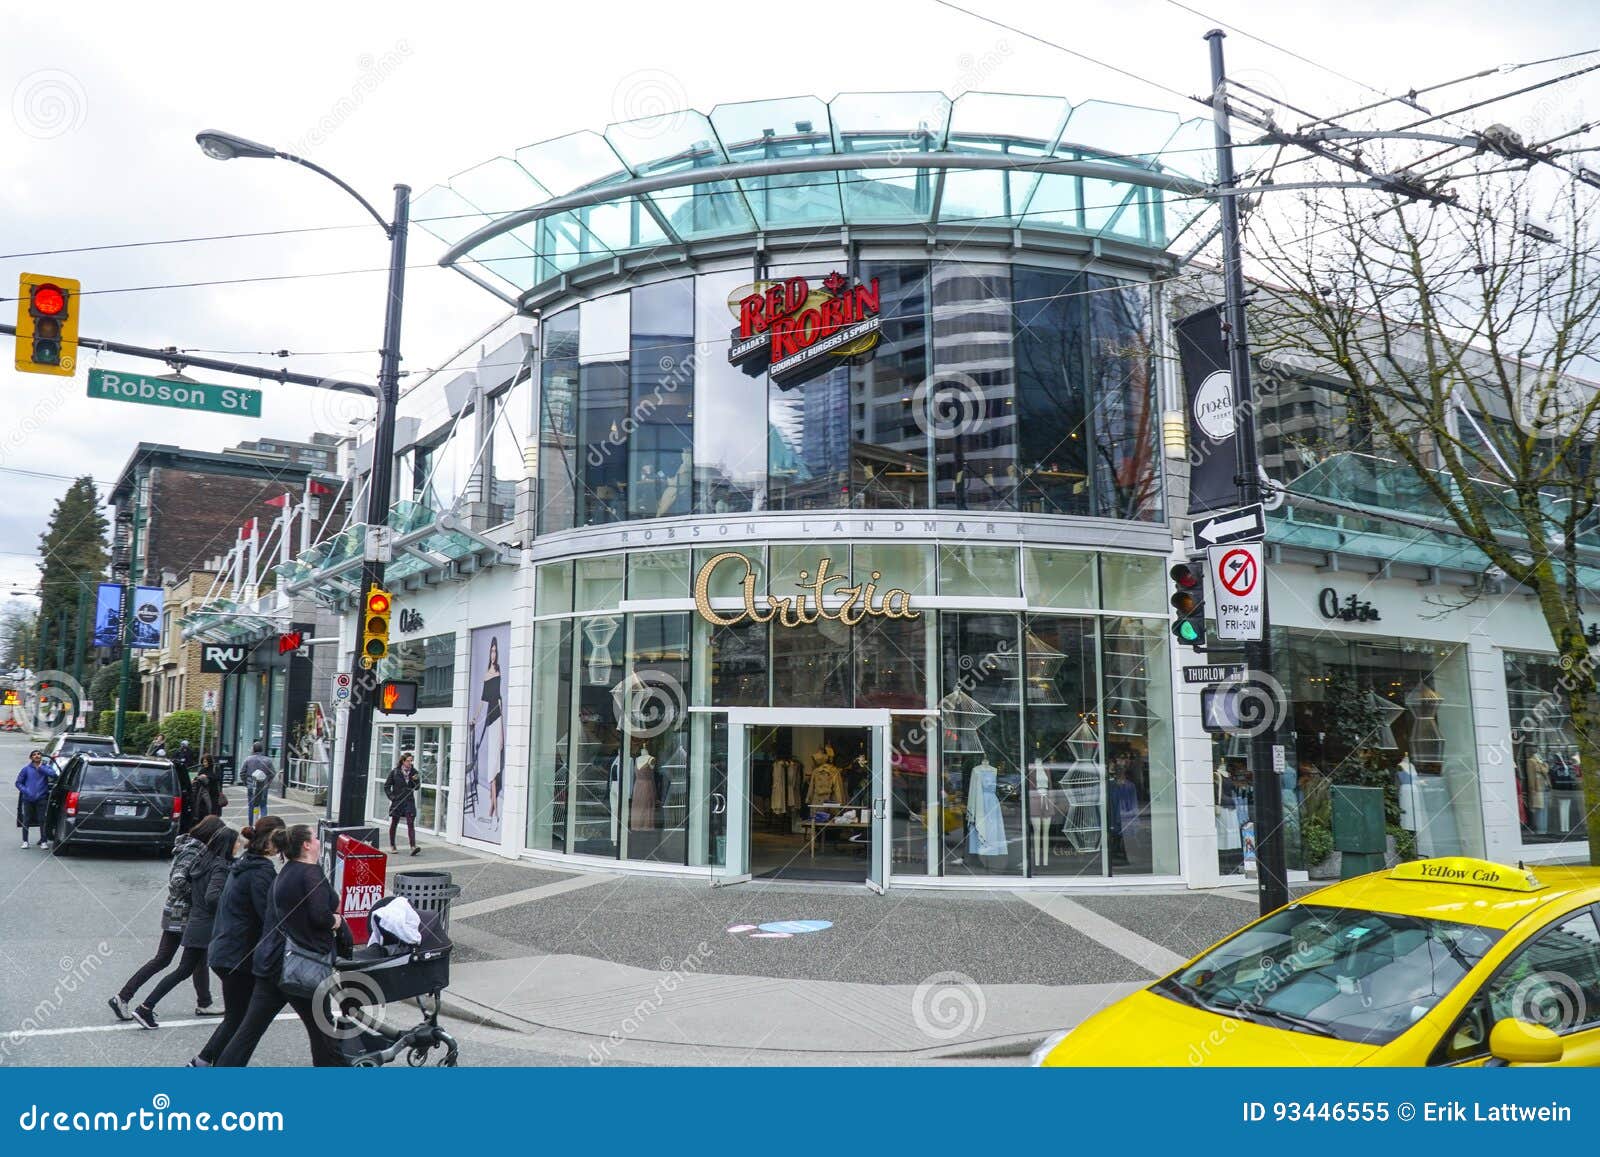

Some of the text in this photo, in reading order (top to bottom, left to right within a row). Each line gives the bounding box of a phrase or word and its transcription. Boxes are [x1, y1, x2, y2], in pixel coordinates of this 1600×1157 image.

[740, 276, 809, 341] RED
[771, 277, 880, 363] ROBIN
[731, 335, 766, 357] CANADA'S
[770, 318, 879, 374] GOURMET BURGERS & SPIRITS
[102, 374, 249, 410] Robson St
[622, 520, 1028, 542] ROBSON LANDMARK
[695, 551, 921, 627] Aritzia
[1221, 604, 1259, 616] 9PM-2AM
[1225, 620, 1256, 630] FRI-SUN
[206, 647, 244, 670] RYU
[1187, 667, 1225, 681] THURLOW
[1420, 864, 1500, 882] Yellow Cab
[346, 885, 383, 894] VISITOR
